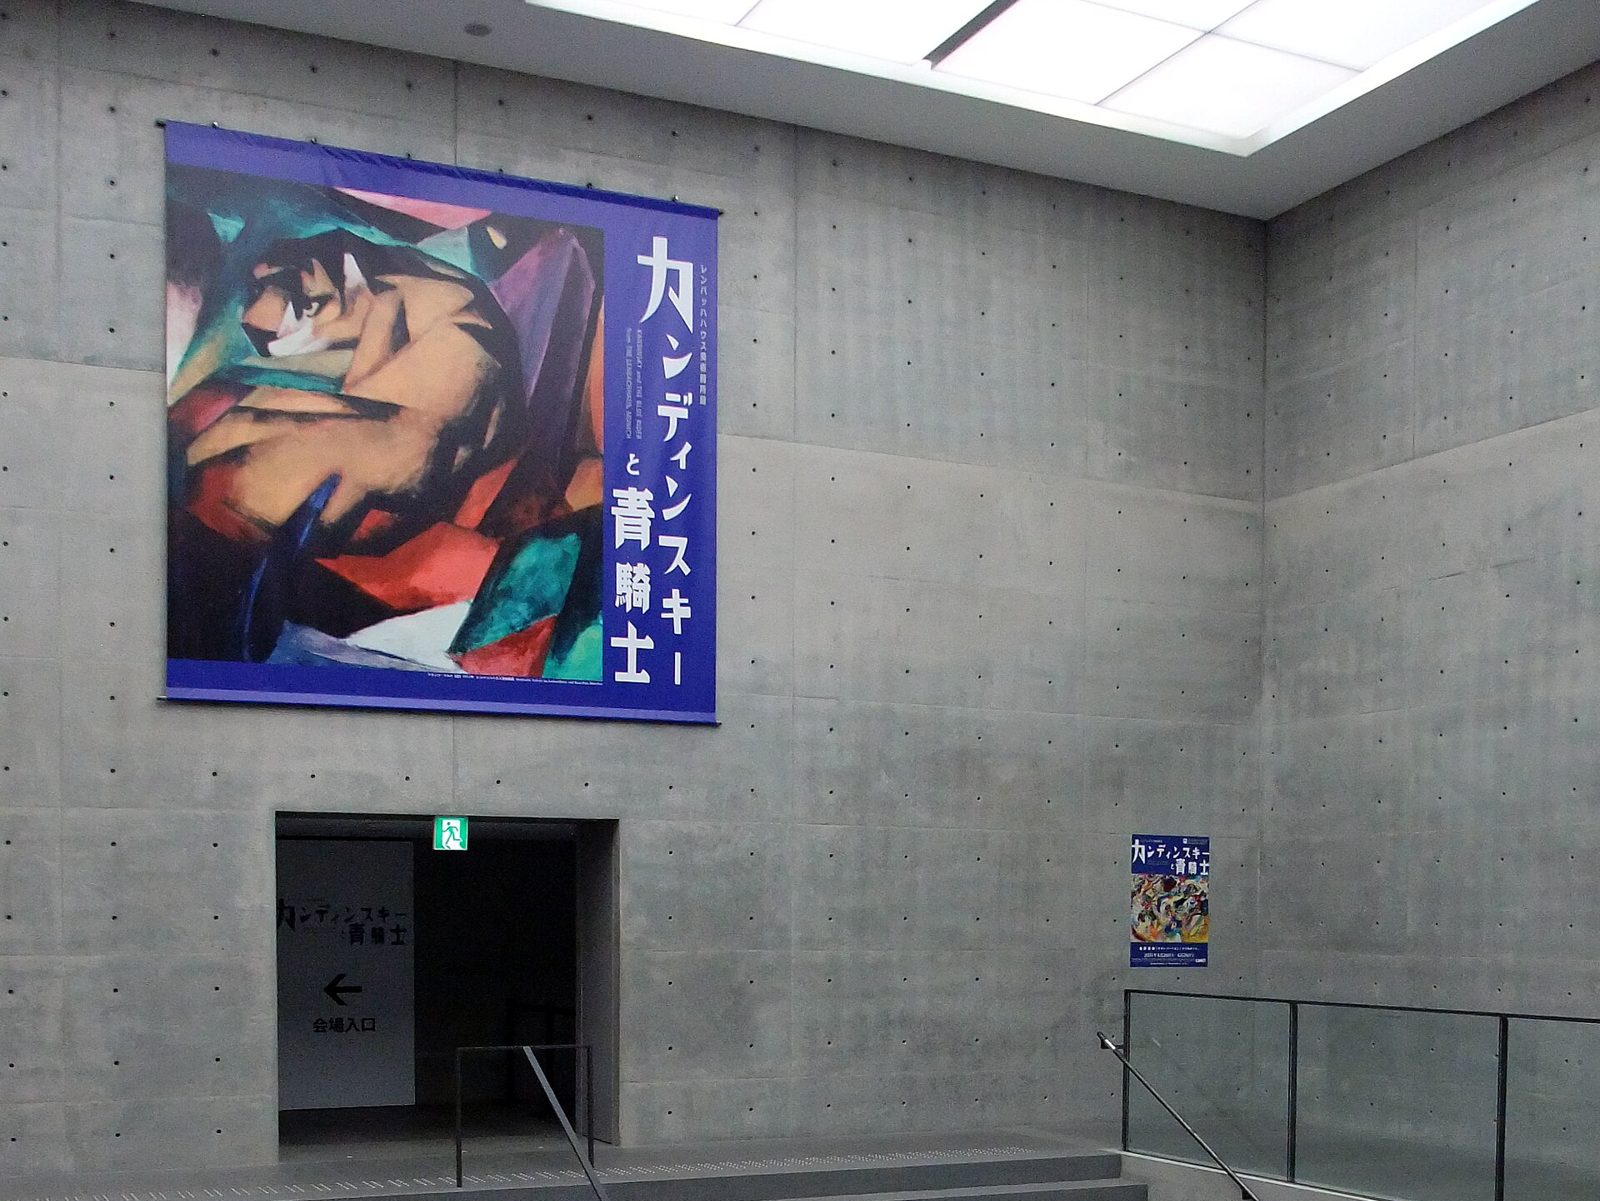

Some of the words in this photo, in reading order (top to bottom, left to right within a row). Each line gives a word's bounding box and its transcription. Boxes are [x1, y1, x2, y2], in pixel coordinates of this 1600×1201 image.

[637, 236, 693, 685] カンディンスキー
[611, 453, 655, 685] と青騎士
[1131, 838, 1210, 864] カンディンスキー
[312, 1017, 376, 1033] 会場入口
